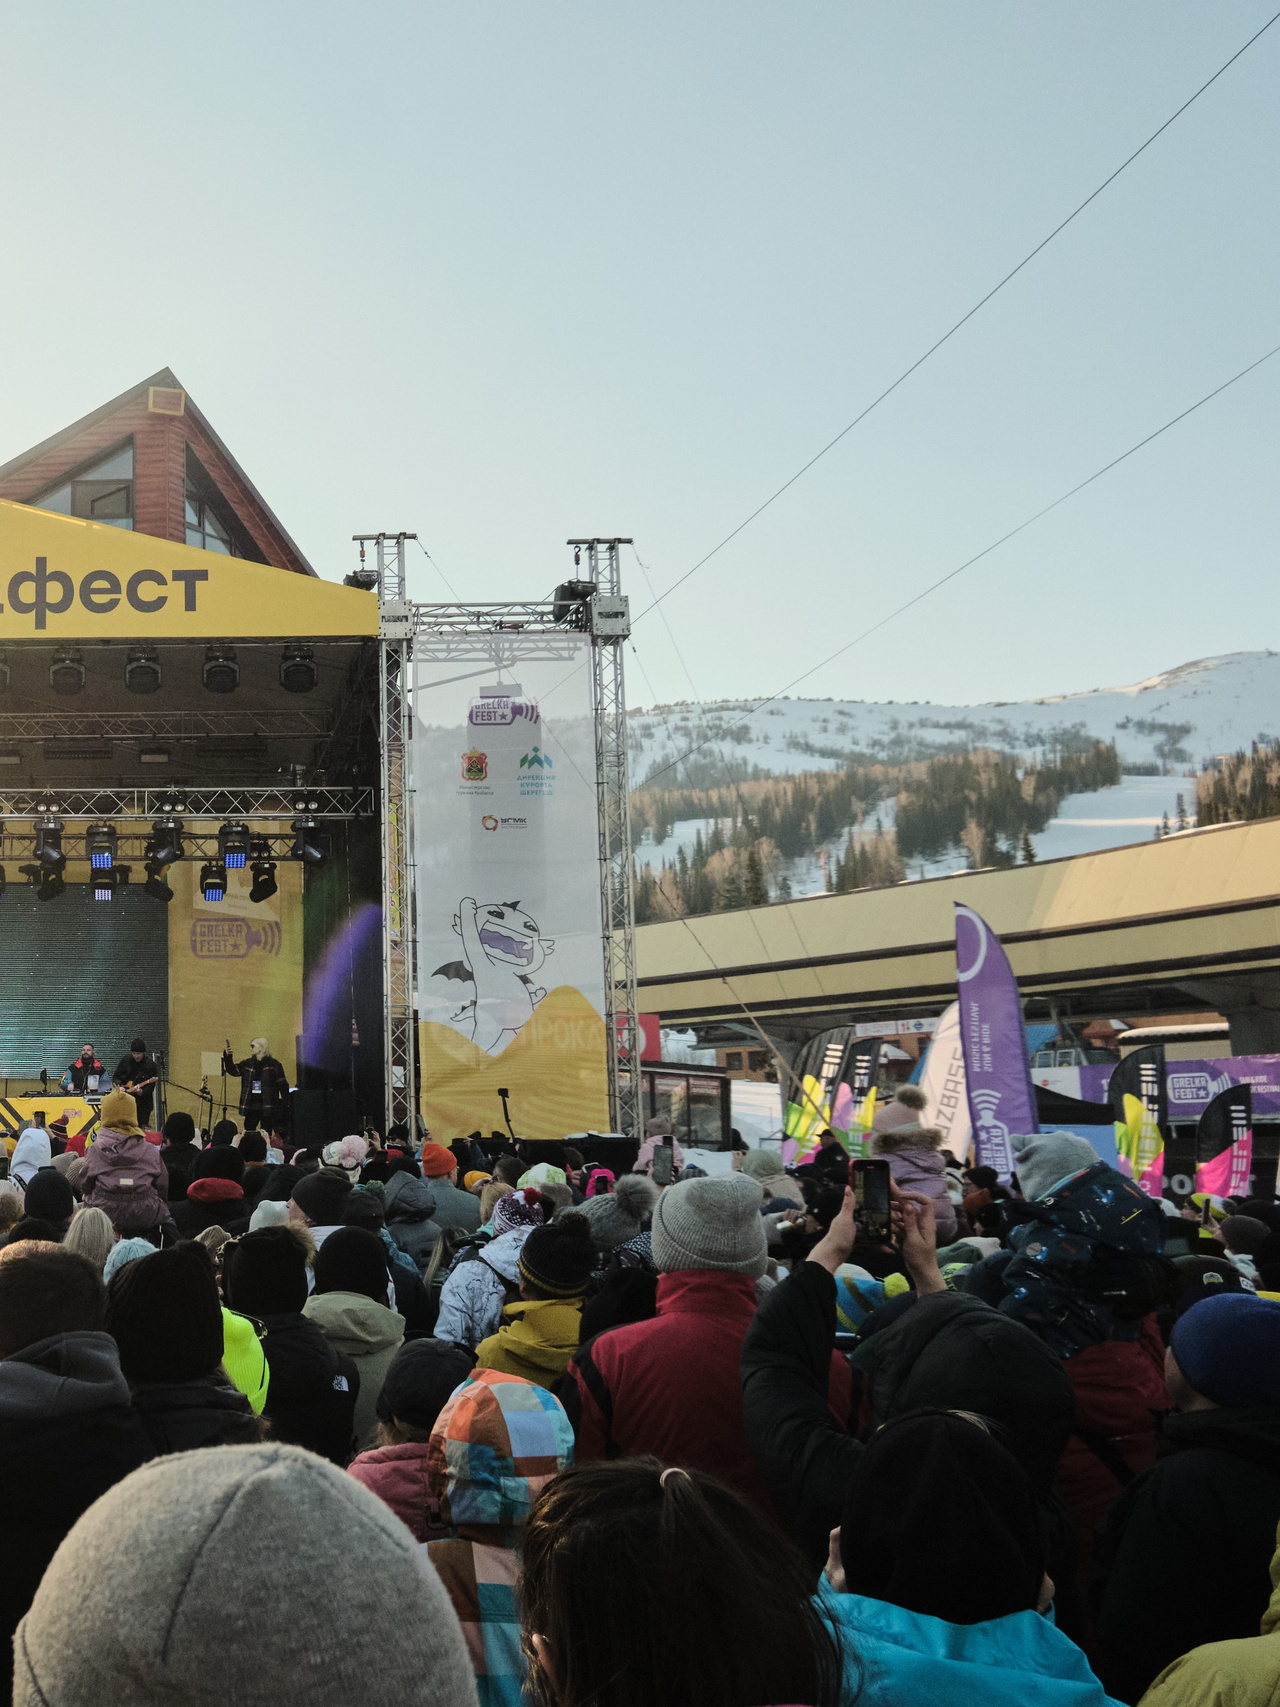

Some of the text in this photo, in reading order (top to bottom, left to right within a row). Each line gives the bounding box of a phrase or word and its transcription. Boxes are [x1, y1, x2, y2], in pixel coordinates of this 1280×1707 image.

[474, 698, 509, 710] GRELKA
[475, 710, 498, 722] FEST
[199, 923, 243, 938] GRELKA
[199, 938, 228, 953] FEST
[1173, 1077, 1207, 1089] GRELKA
[933, 1047, 966, 1142] UZBAS
[1174, 1088, 1198, 1099] FEST
